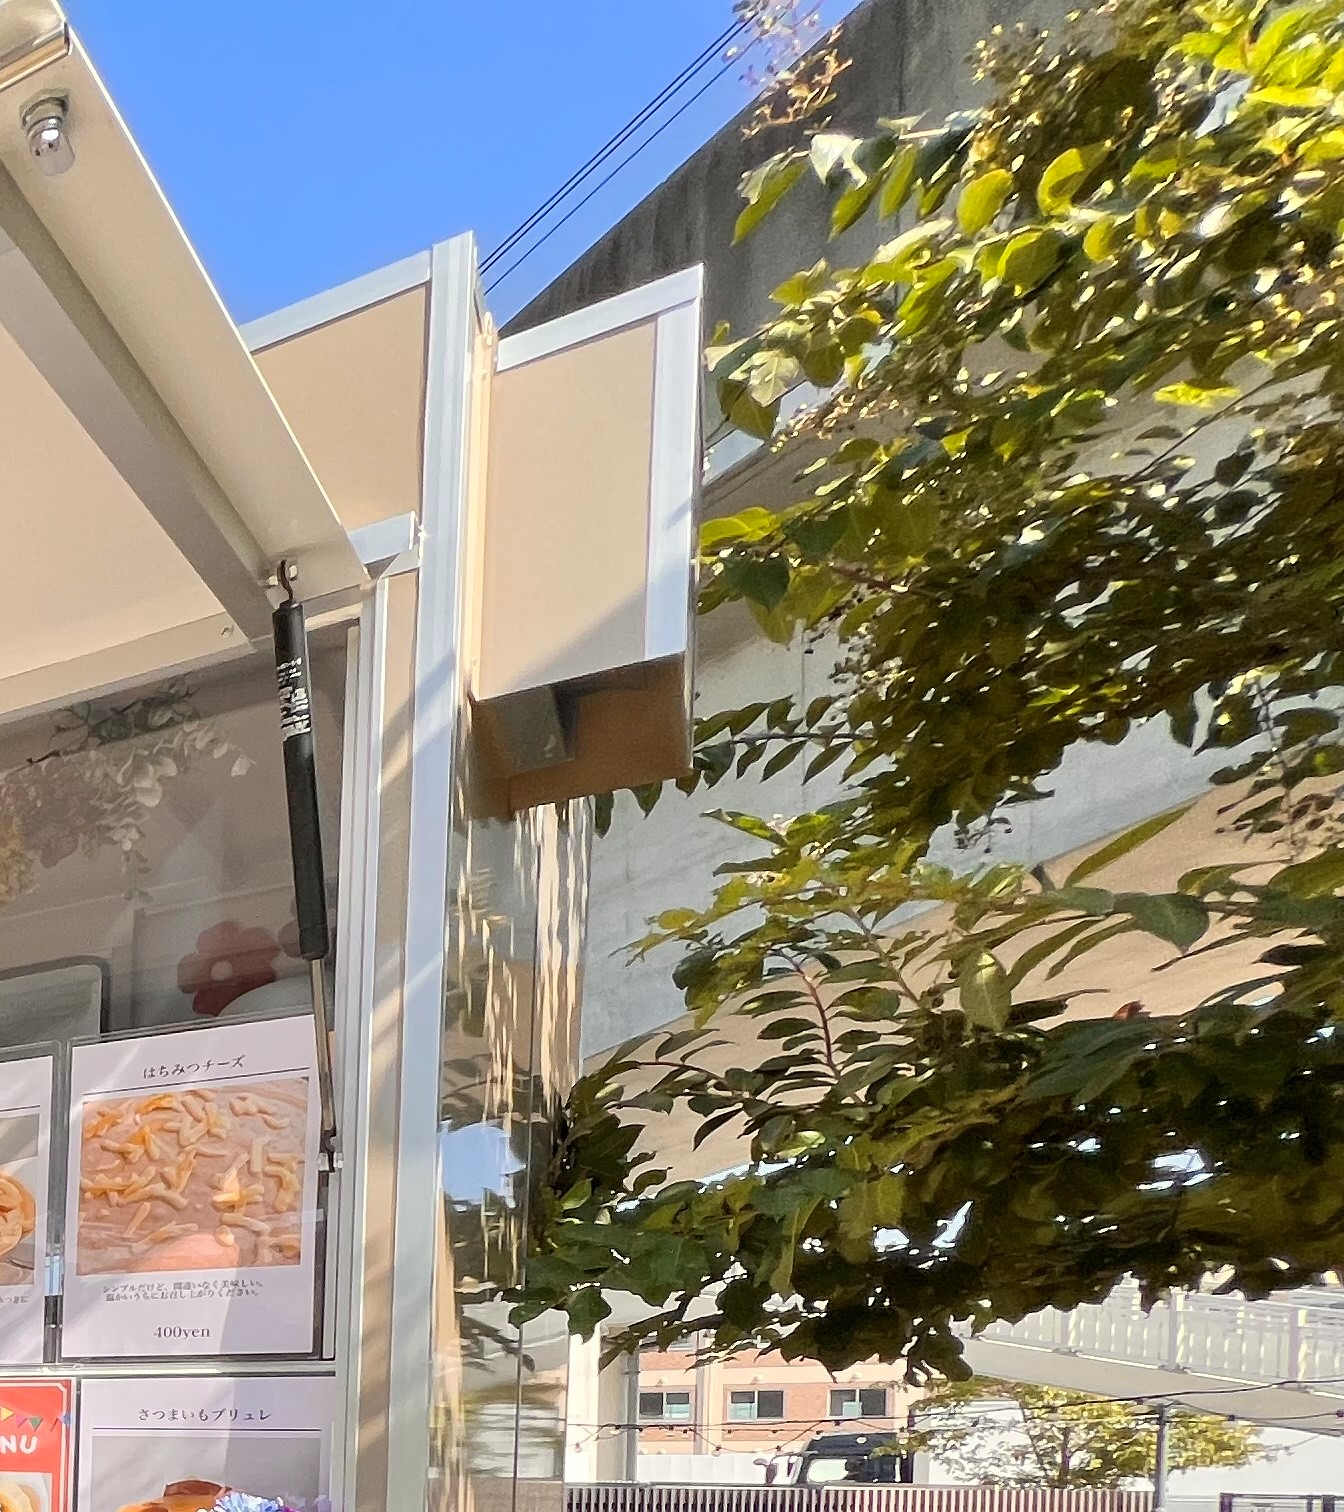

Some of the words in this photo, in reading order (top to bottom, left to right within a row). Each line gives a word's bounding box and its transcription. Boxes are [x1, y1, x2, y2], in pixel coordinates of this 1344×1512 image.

[144, 1054, 246, 1079] はちみつチーズ
[153, 1325, 211, 1340] 400yen
[138, 1408, 272, 1421] さつまいもブリュレ
